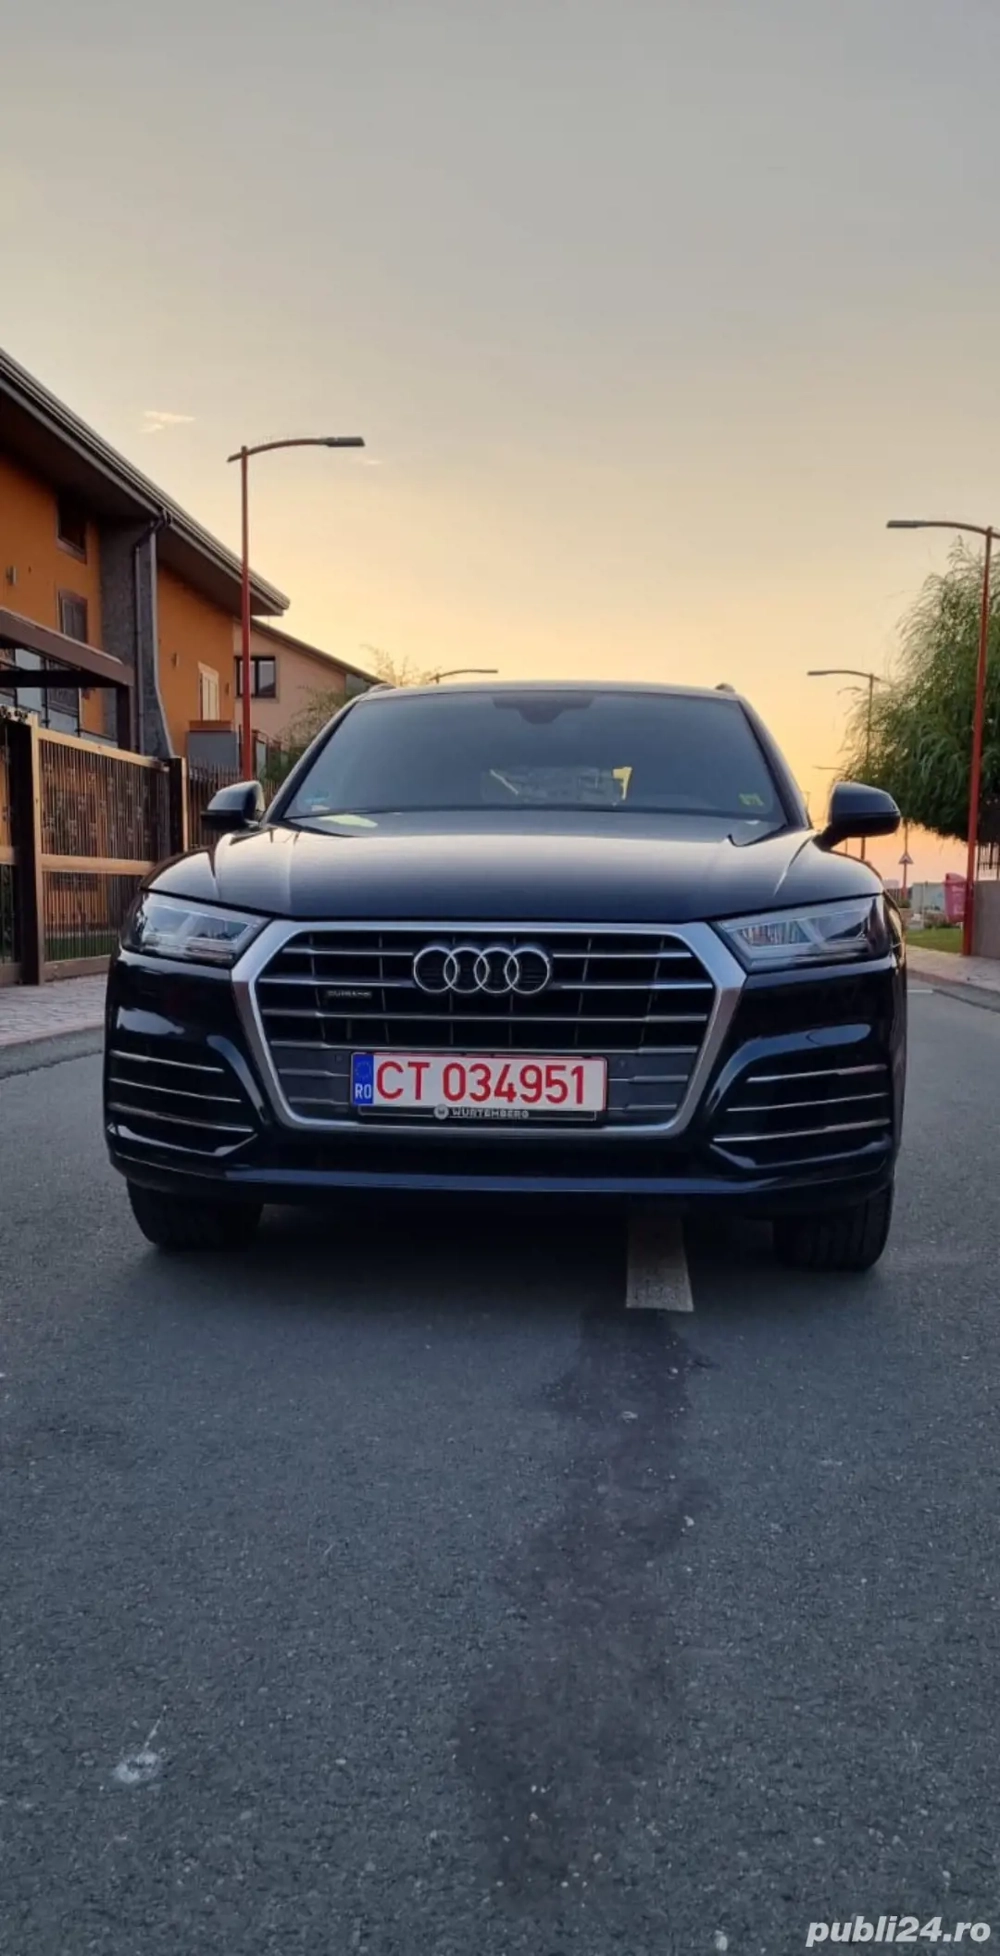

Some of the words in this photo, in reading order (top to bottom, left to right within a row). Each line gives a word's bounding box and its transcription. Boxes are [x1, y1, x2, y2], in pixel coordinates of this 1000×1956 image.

[355, 1083, 372, 1099] RO
[376, 1061, 430, 1101] CT
[442, 1062, 584, 1105] 034951
